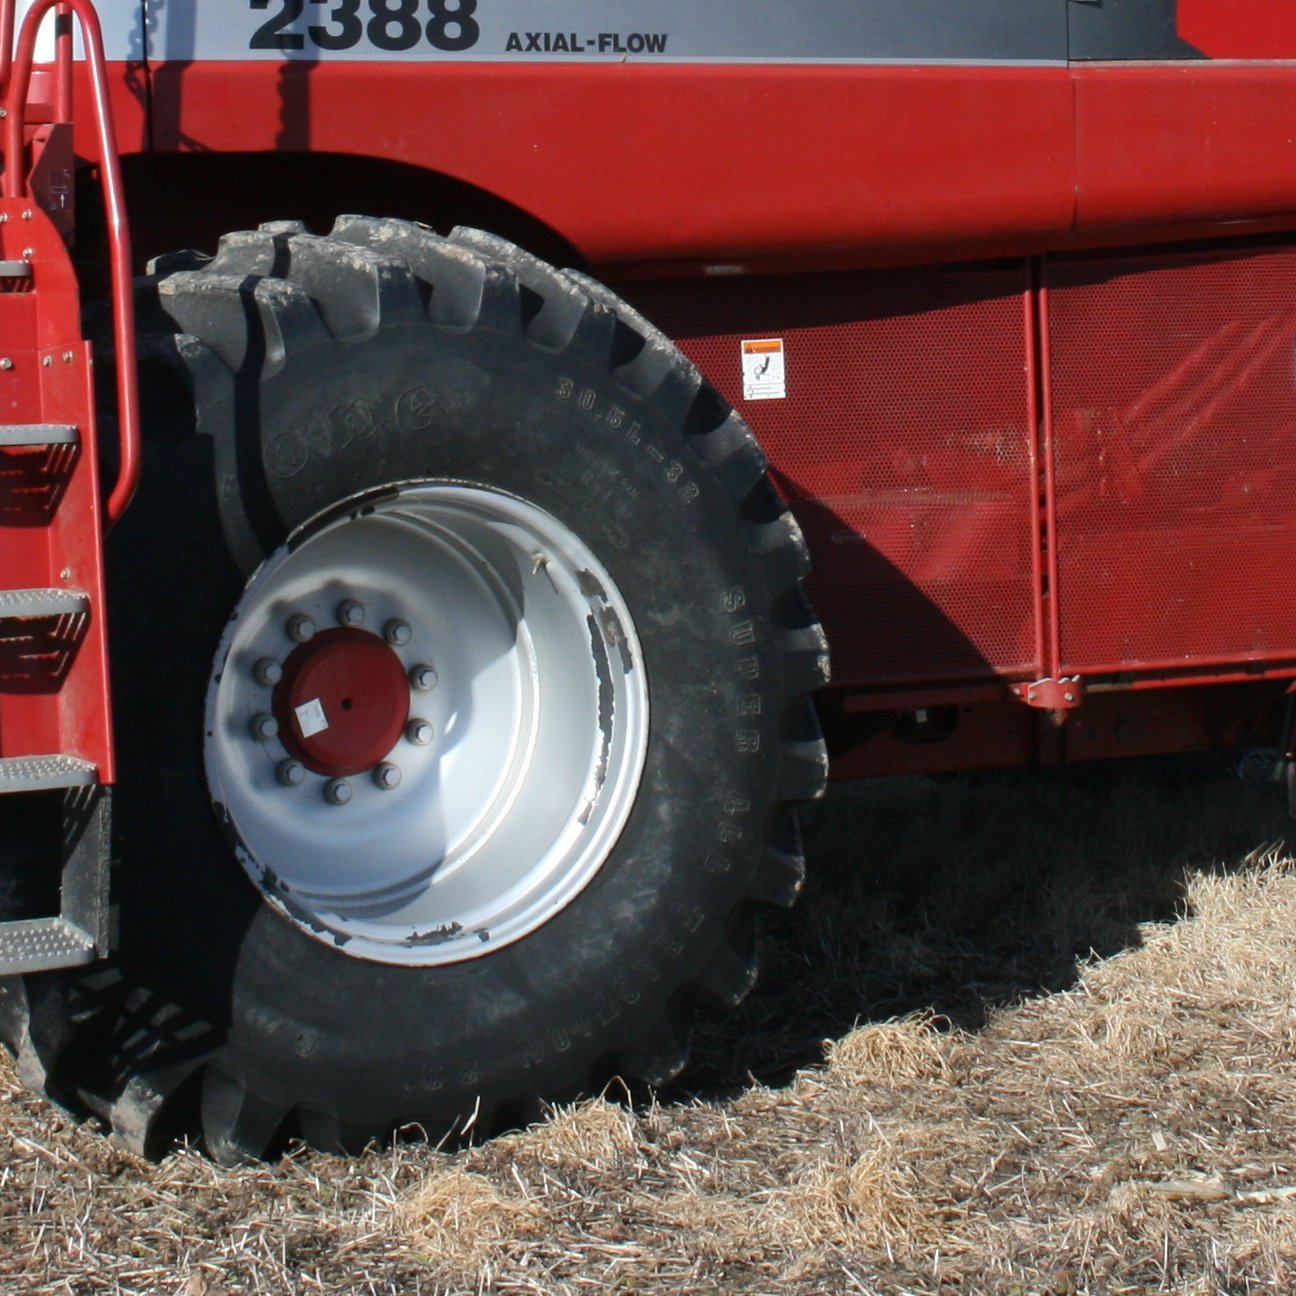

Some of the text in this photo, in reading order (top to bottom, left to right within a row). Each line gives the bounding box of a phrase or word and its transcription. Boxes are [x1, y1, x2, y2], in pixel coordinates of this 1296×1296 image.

[505, 31, 668, 53] AXIAL-FLOW
[721, 586, 762, 754] SUPER
[703, 791, 751, 873] ALL
